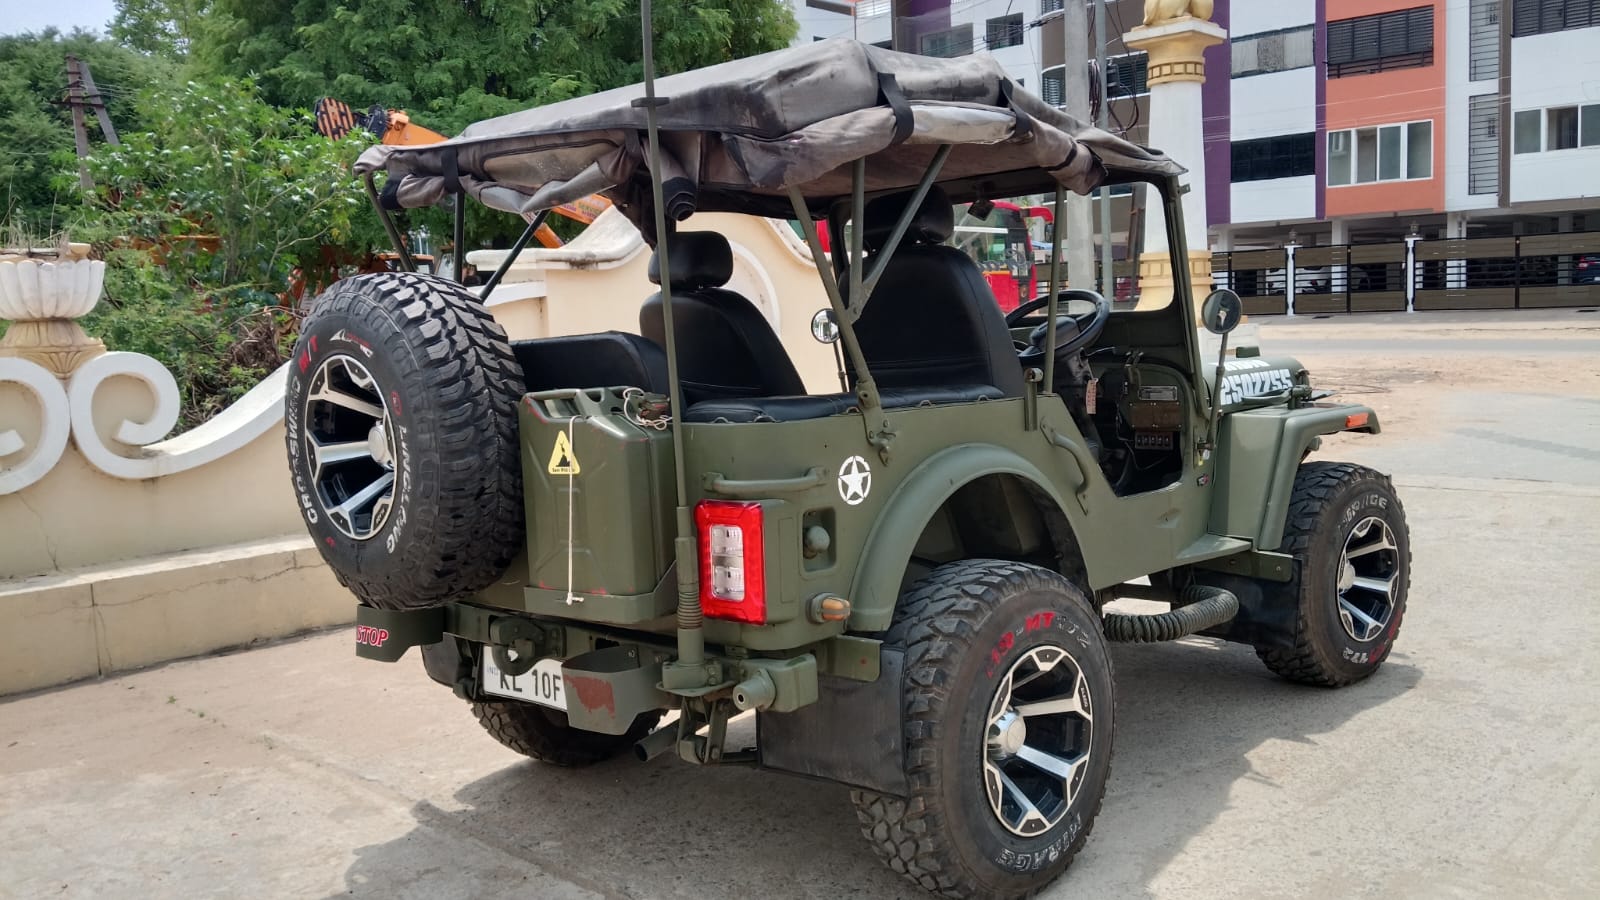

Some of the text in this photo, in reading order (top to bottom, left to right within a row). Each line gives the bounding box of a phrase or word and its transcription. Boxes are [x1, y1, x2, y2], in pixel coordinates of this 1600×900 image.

[357, 625, 389, 647] STOP
[500, 669, 561, 702] KL 10F
